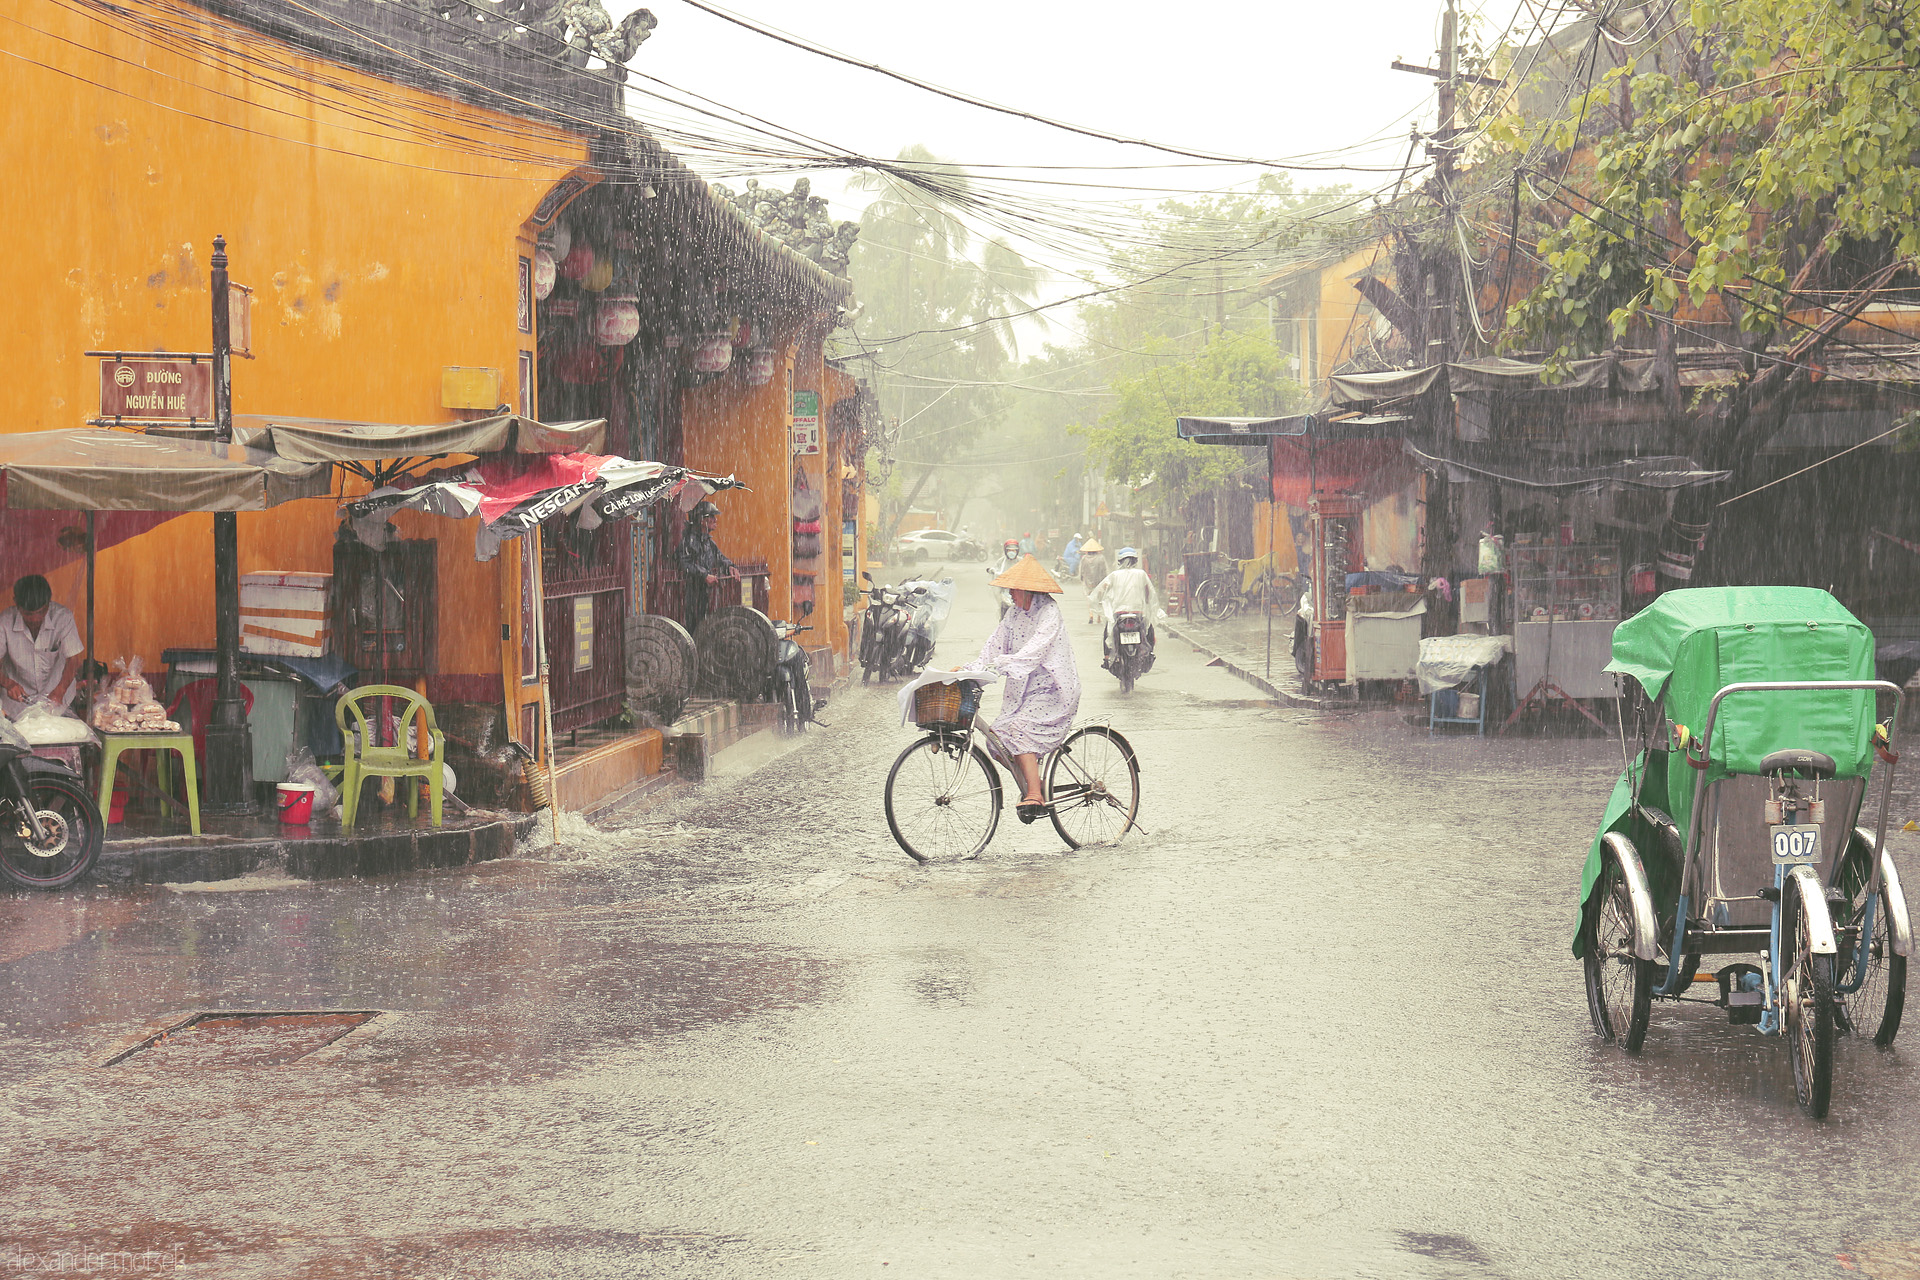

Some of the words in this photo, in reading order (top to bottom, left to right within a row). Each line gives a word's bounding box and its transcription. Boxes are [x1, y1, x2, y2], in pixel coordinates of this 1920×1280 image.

[146, 368, 182, 384] ĐƯỜNG
[126, 390, 164, 410] NGUYỄN
[167, 393, 186, 413] HUỆ
[1775, 831, 1817, 857] 007
